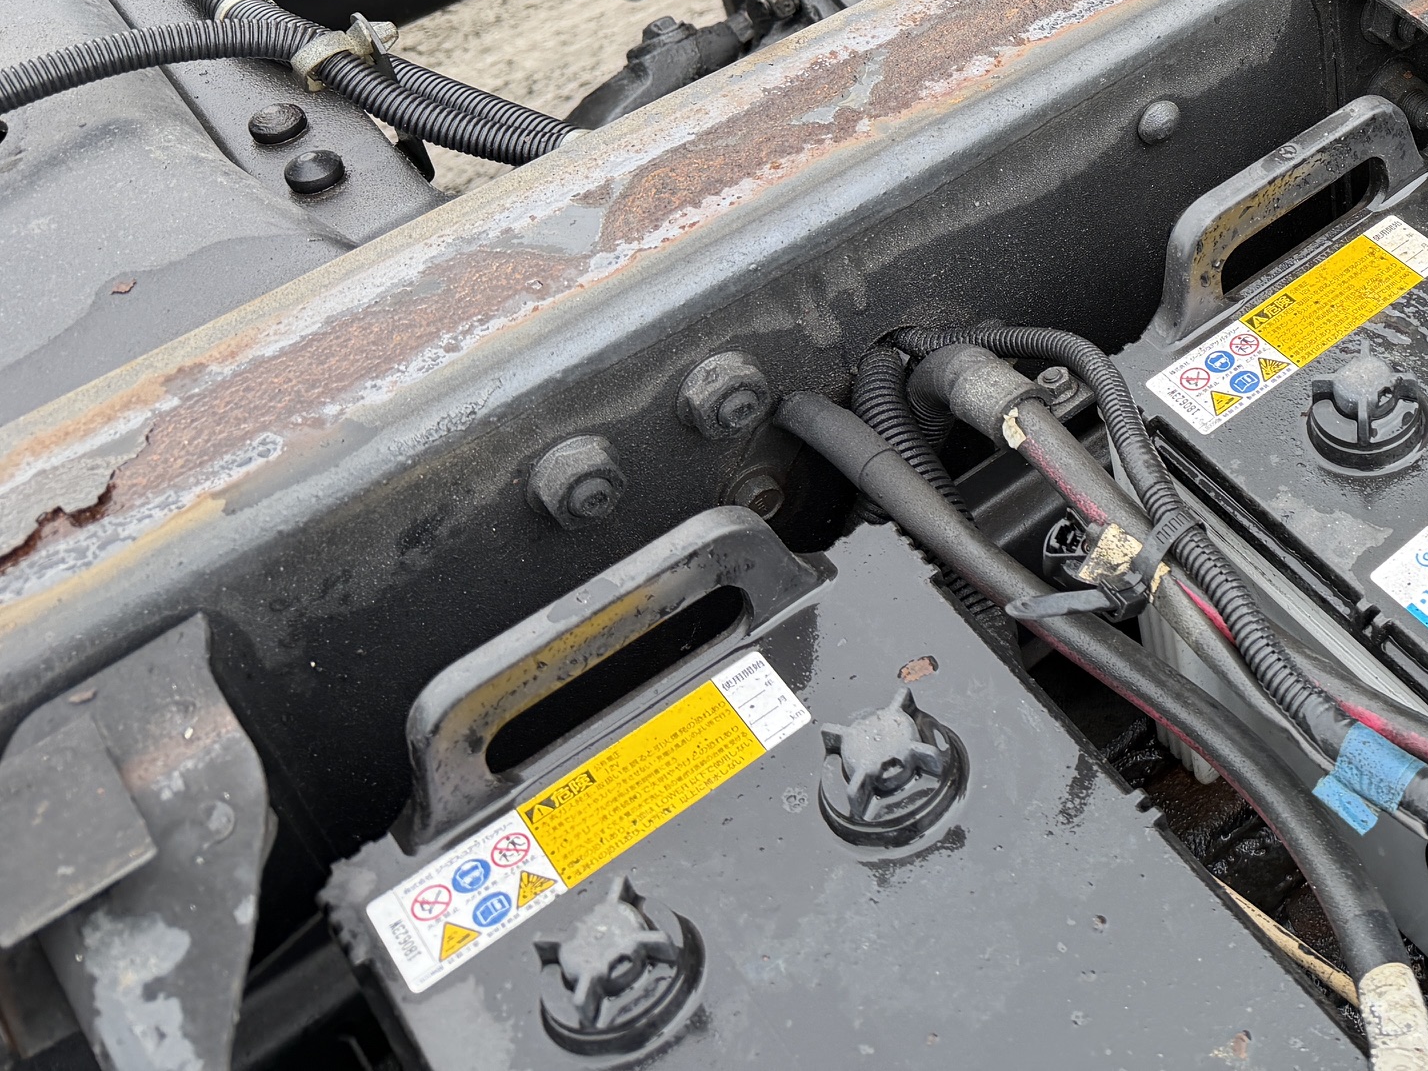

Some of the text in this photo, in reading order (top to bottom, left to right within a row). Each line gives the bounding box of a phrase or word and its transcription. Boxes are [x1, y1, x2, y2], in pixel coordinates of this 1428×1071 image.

[1260, 294, 1294, 318] 危険
[719, 658, 766, 692] 使用開始
[788, 707, 806, 721] km
[604, 760, 621, 775] 12V
[547, 771, 594, 808] 危険
